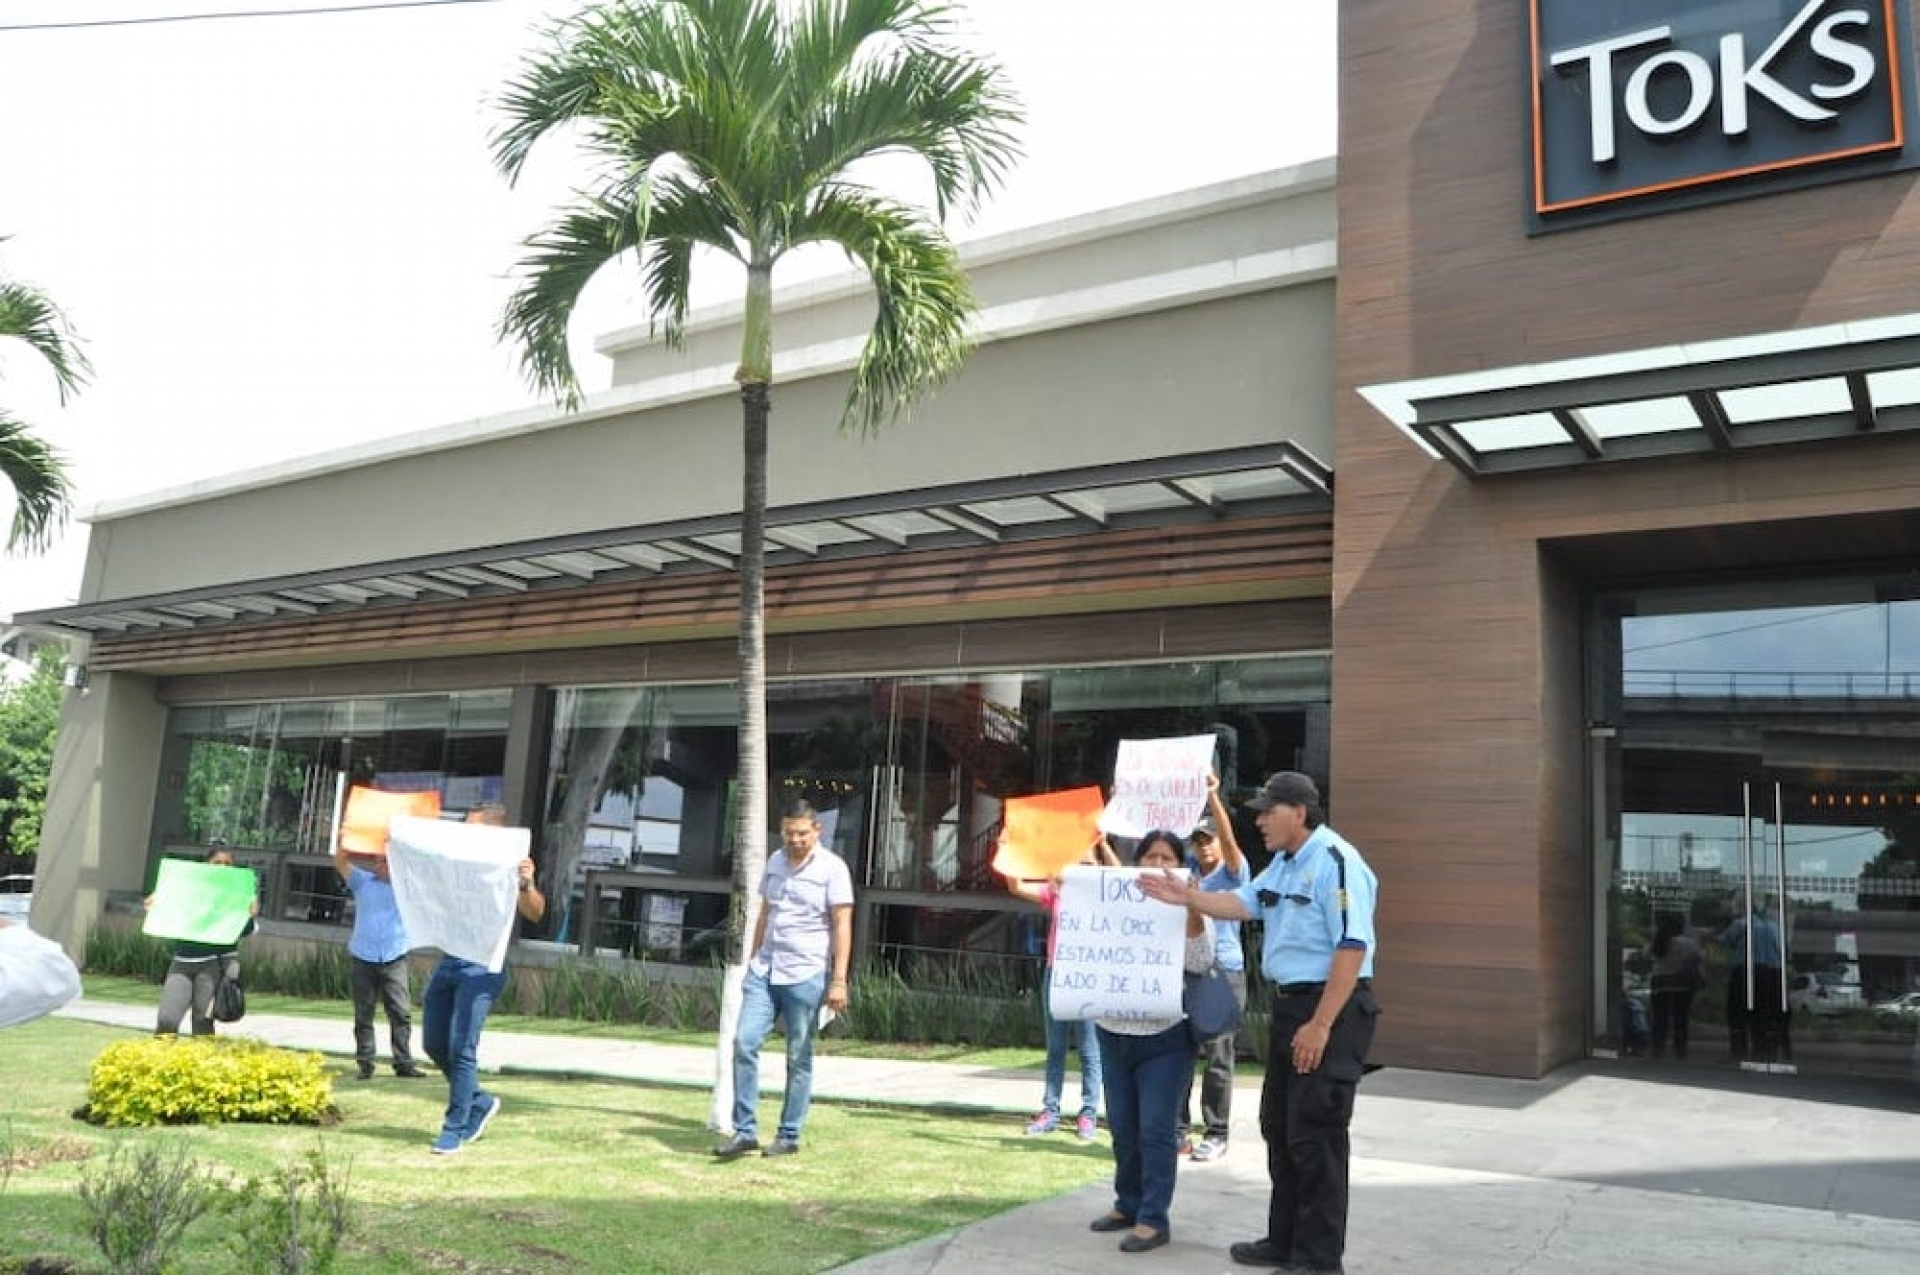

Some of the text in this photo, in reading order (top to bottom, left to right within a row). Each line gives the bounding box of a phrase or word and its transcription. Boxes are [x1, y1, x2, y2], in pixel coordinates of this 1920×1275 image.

[1060, 911, 1080, 931] EN
[1090, 913, 1111, 932] LA
[1056, 944, 1174, 967] ESTAMOS DEL
[1053, 970, 1163, 995] LADO DE LA
